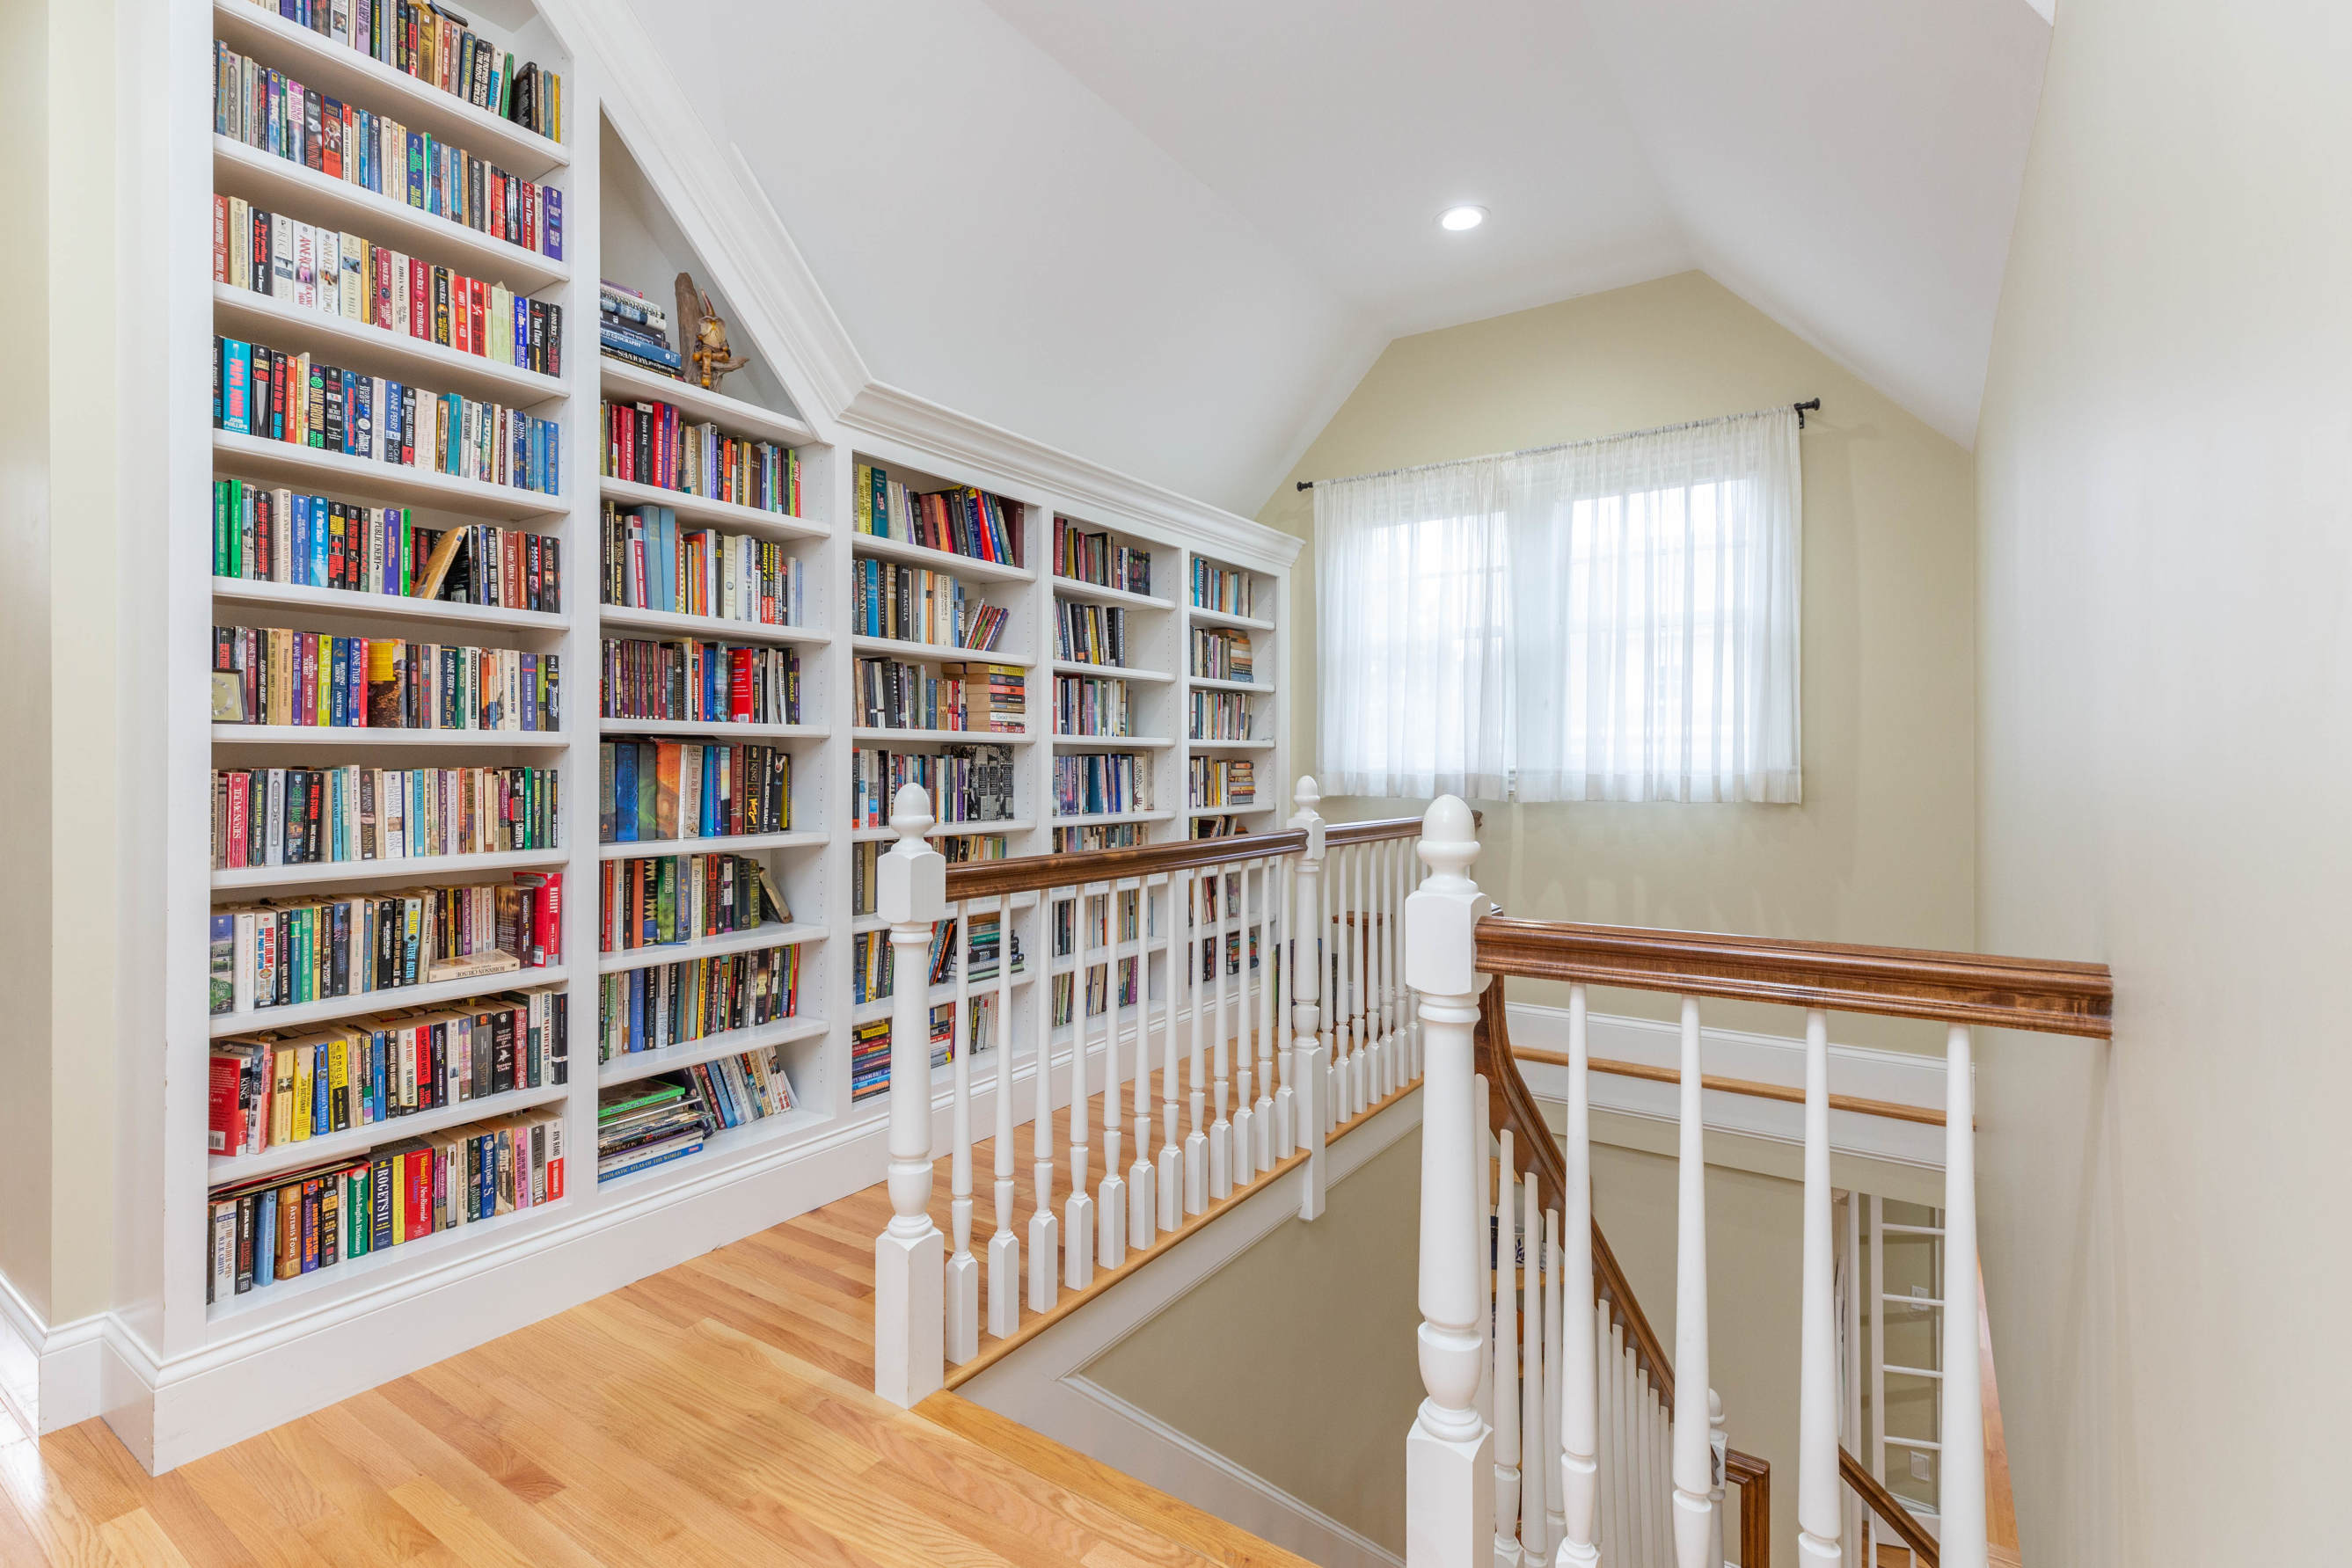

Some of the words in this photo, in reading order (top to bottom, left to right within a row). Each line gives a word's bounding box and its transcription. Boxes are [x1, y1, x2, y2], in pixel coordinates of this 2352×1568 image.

[299, 235, 310, 255] ANNE
[299, 252, 311, 271] RICE
[534, 317, 543, 330] Tom
[533, 328, 543, 348] Clancy
[230, 358, 244, 388] PAPA
[310, 387, 323, 404] DAN
[310, 403, 323, 431] BROWN
[390, 411, 398, 432] PERRY
[405, 424, 414, 447] CONNELLY
[858, 560, 866, 612] COMMUNION
[446, 658, 455, 674] ANNE
[291, 787, 302, 806] GREEN
[310, 784, 319, 799] FIRE
[291, 806, 301, 822] MARS
[310, 799, 318, 820] STORM
[409, 909, 418, 934] GOLIATH
[265, 927, 274, 944] ROBERT
[265, 944, 274, 969] LUDLUM'S
[407, 942, 417, 960] STEVE
[406, 960, 415, 978] ALTEN
[377, 1169, 388, 1213] ROGET'S
